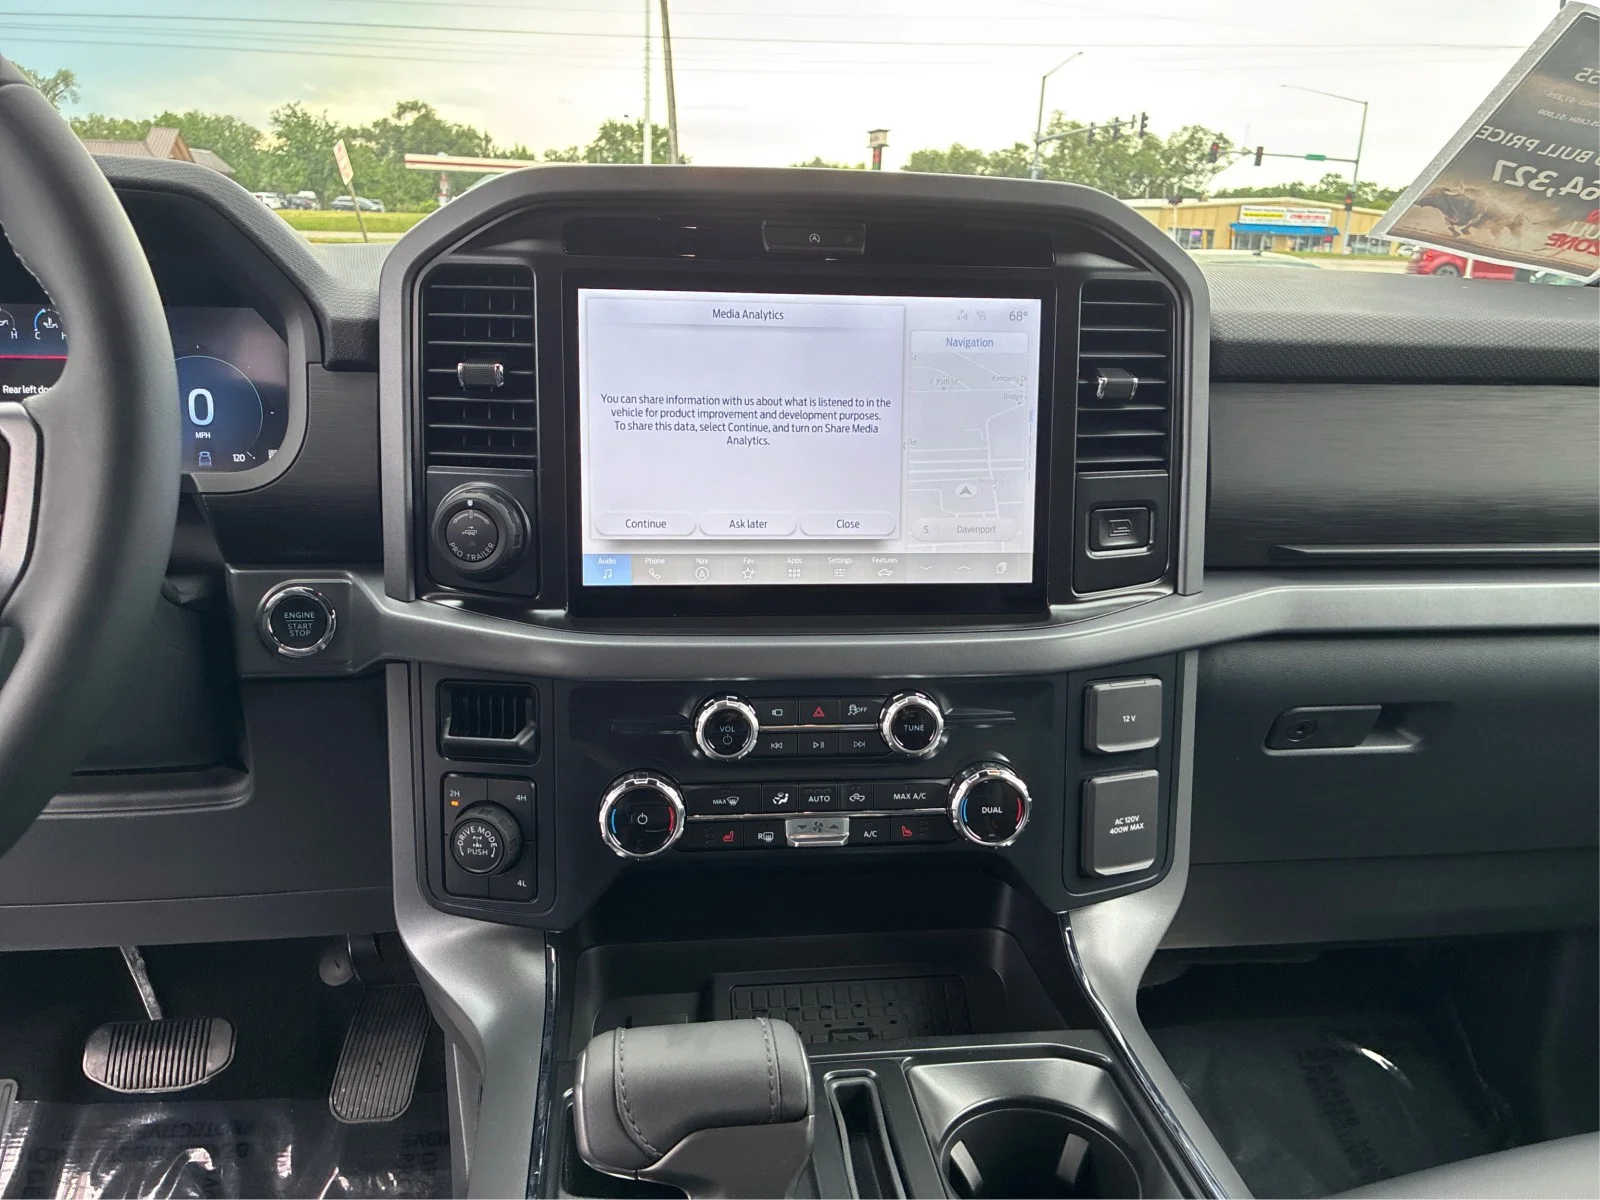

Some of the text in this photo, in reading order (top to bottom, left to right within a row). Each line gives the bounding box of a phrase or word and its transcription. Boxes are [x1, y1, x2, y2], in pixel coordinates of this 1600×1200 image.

[712, 308, 784, 320] Media Analytics
[11, 331, 18, 340] H
[35, 332, 41, 340] C
[946, 337, 994, 348] Navigation
[2, 385, 21, 394] Rear
[22, 385, 36, 394] left
[600, 394, 619, 404] You
[620, 396, 637, 404] can
[638, 394, 664, 404] share
[666, 395, 720, 405] information
[722, 396, 742, 405] with
[756, 396, 783, 406] about
[785, 397, 808, 406] what
[810, 397, 816, 406] is
[818, 397, 853, 407] listened
[855, 398, 864, 407] to
[866, 398, 875, 407] in
[876, 398, 891, 408] the
[188, 388, 214, 426] 0
[611, 408, 881, 421] vehicle for product improvement and development purposes.
[614, 420, 626, 430] To
[628, 421, 653, 430] share
[655, 421, 672, 431] this
[674, 421, 698, 432] data,
[699, 422, 726, 431] select
[728, 422, 771, 433] Continue,
[772, 423, 789, 433] and
[792, 424, 810, 433] turn
[825, 423, 850, 433] Share
[852, 423, 878, 433] Media
[727, 436, 770, 446] Analytics.
[232, 454, 246, 462] 120
[625, 519, 666, 528] Continue
[729, 519, 768, 528] Ask later
[836, 519, 860, 528] Close
[957, 525, 996, 535] Davenport
[449, 542, 495, 560] PRO TRAILER
[787, 557, 802, 565] Apps
[1125, 815, 1139, 824] 120V
[1109, 822, 1144, 835] 400W MAX
[457, 826, 497, 848] DRIVE MODE
